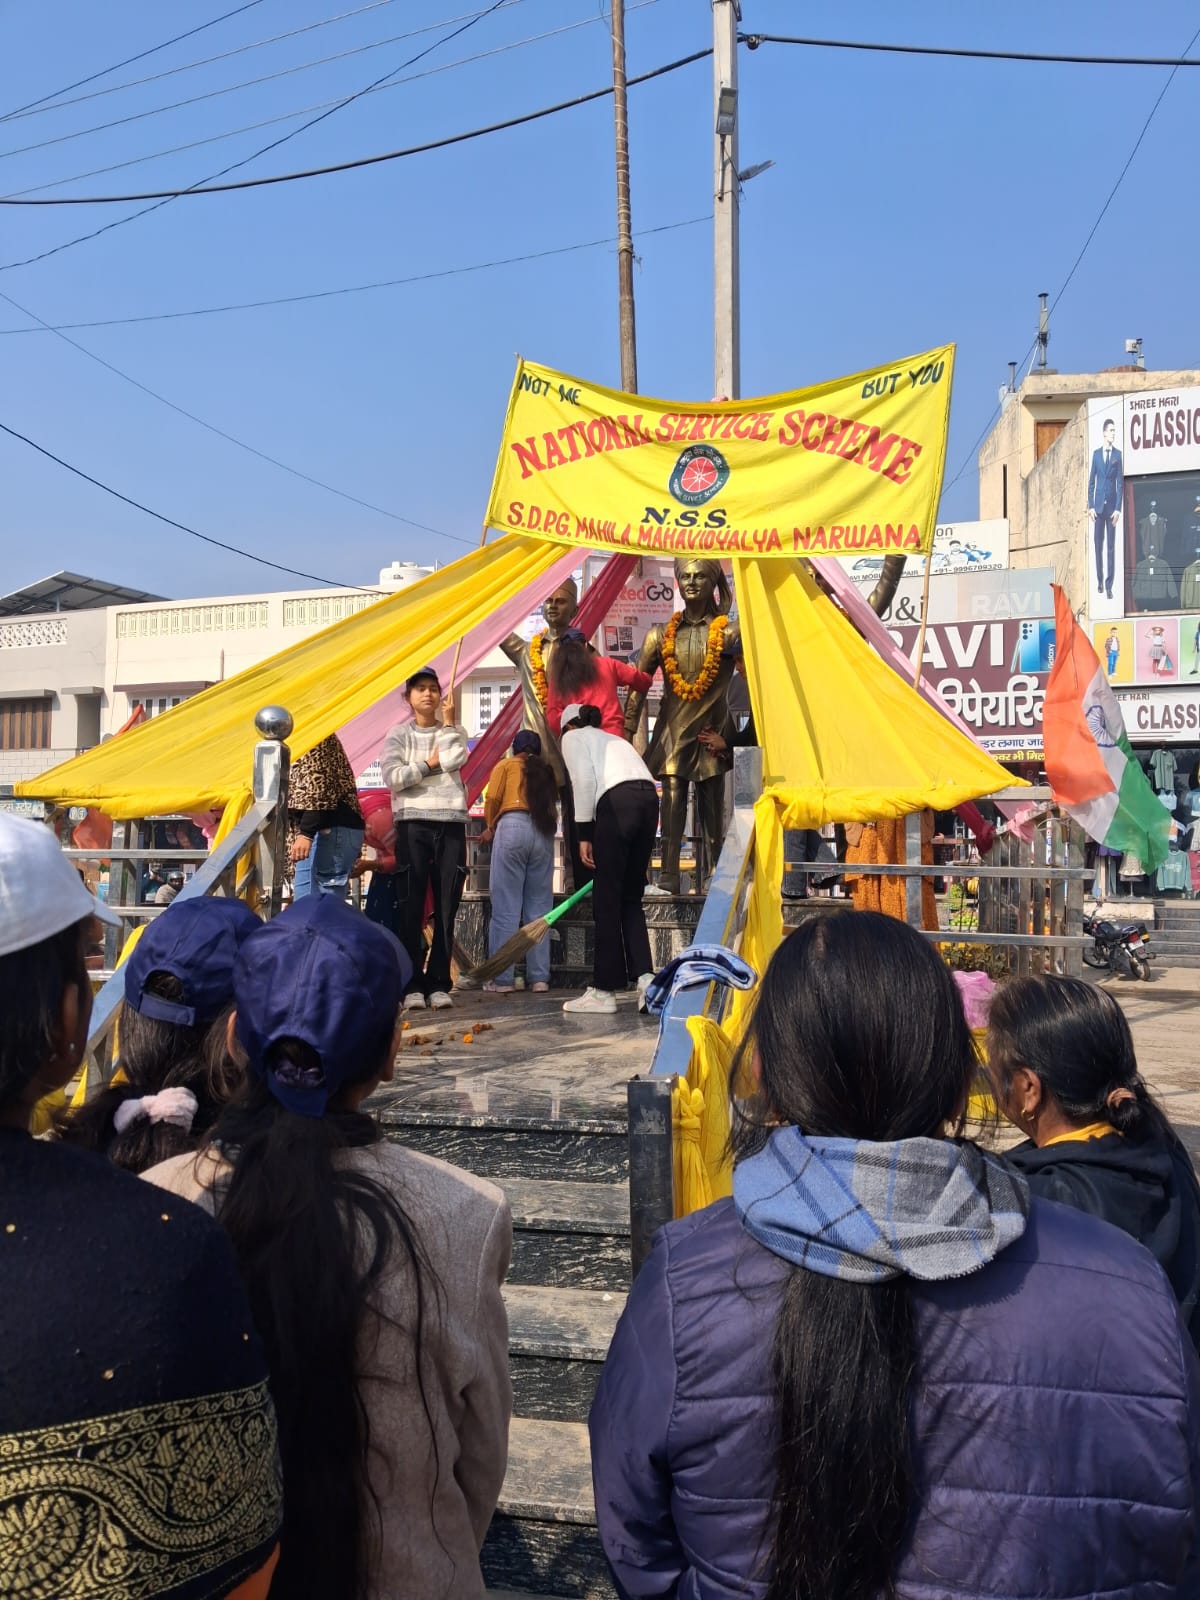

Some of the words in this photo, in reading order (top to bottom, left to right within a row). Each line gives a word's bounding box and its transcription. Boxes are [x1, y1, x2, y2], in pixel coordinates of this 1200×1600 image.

[518, 372, 552, 397] NOT
[558, 384, 582, 406] ME
[861, 372, 902, 399] BUT
[908, 360, 945, 389] YOU
[1130, 398, 1157, 411] SHREE
[1158, 395, 1180, 408] HARI
[510, 414, 653, 480] NATIONAL
[654, 412, 776, 443] SERVICE
[778, 409, 924, 486] SCHEME
[575, 515, 631, 546] MAHILA
[793, 523, 922, 551] NARWANA
[640, 506, 731, 529] N.S.S.
[1129, 692, 1150, 701] HARI
